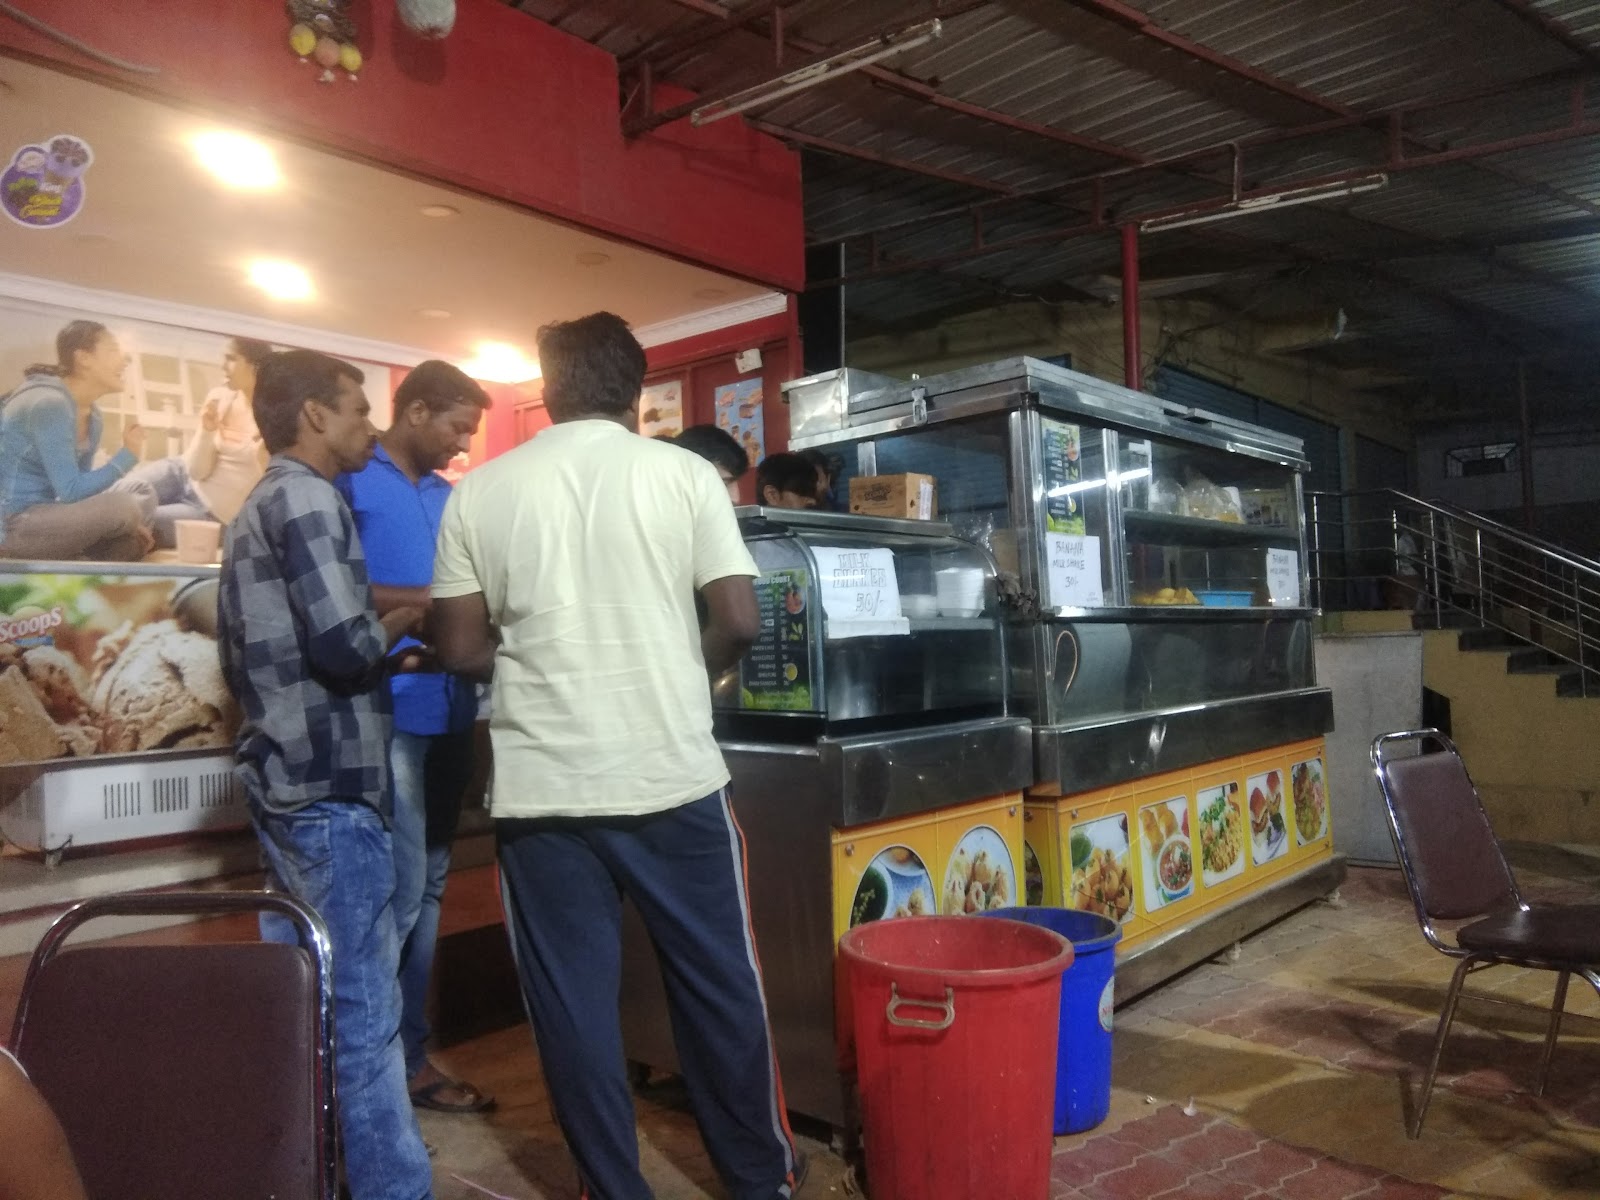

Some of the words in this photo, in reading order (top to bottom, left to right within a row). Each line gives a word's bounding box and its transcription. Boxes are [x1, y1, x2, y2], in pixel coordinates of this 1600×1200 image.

[1055, 541, 1084, 556] BANANA
[838, 553, 870, 569] MILK
[771, 575, 790, 584] COURT
